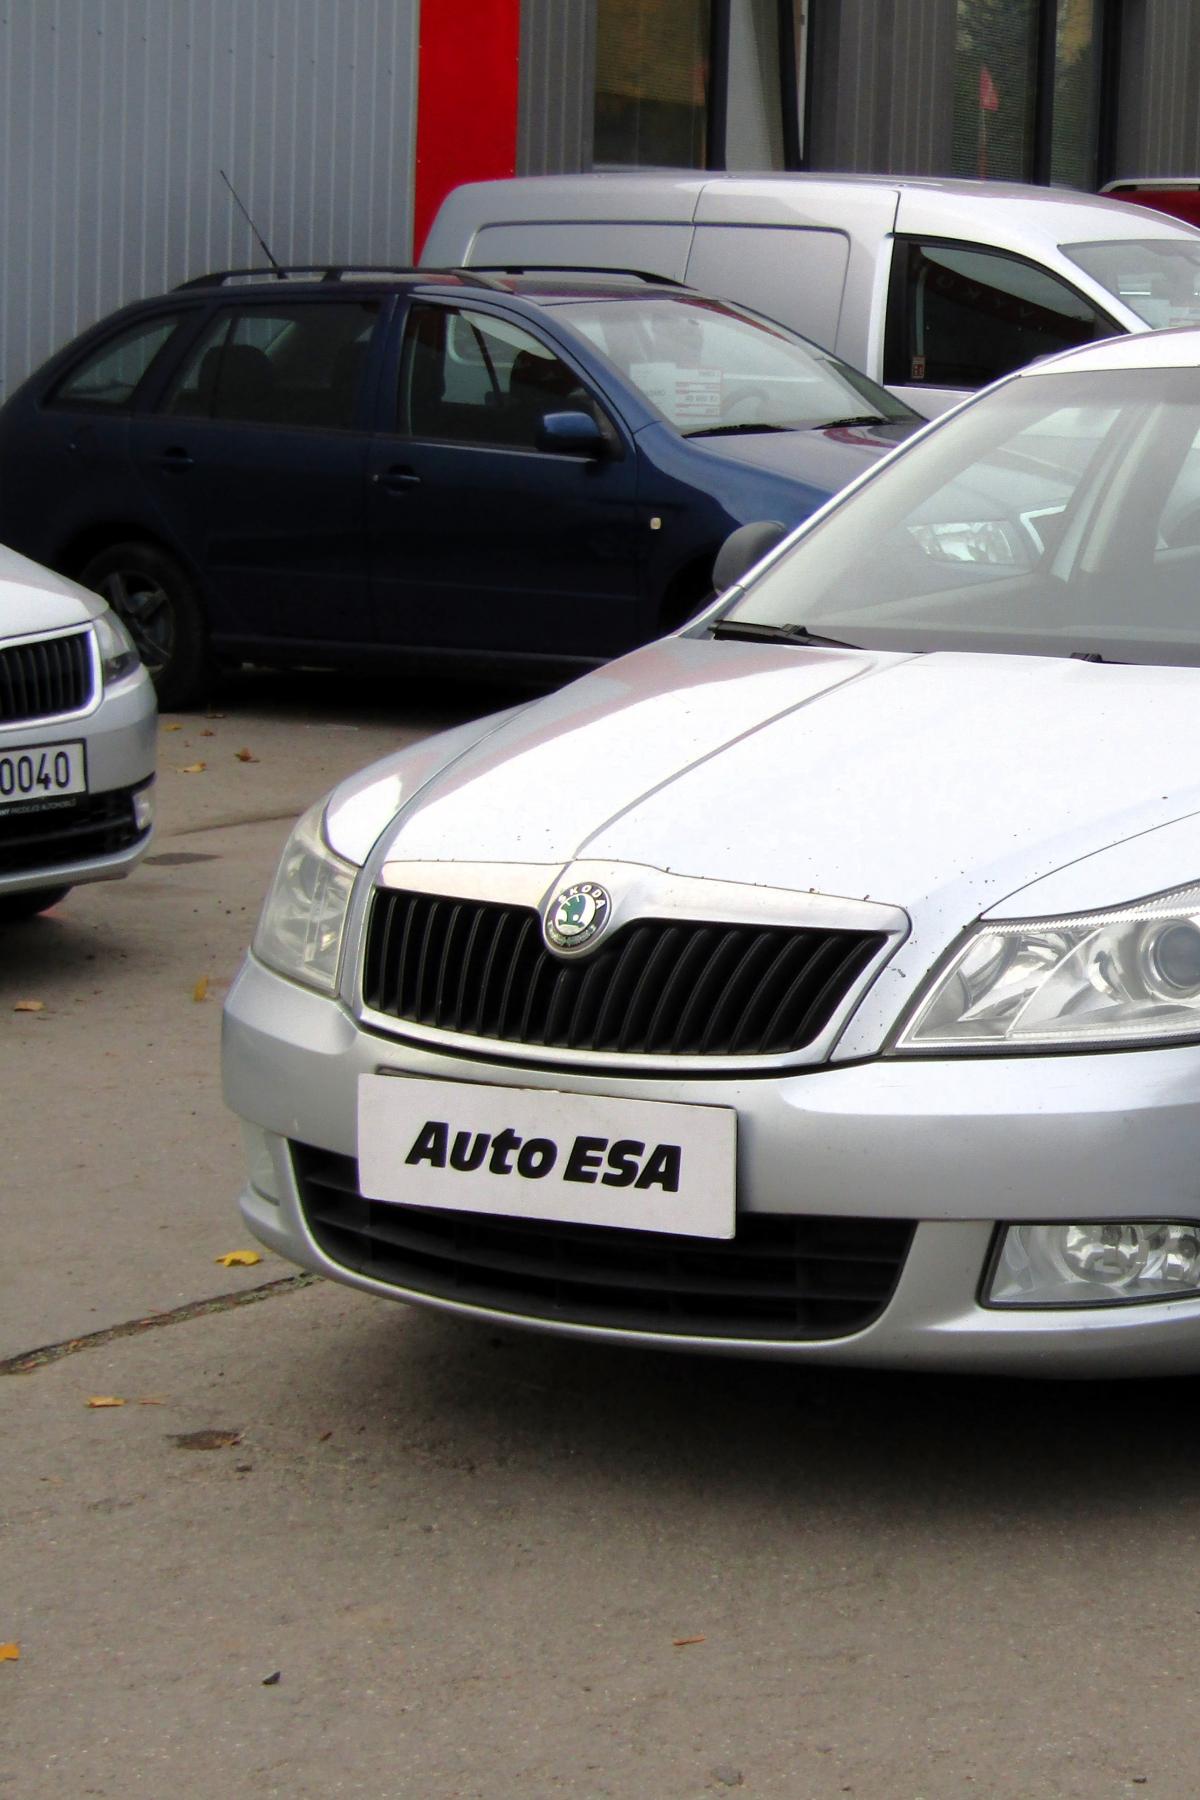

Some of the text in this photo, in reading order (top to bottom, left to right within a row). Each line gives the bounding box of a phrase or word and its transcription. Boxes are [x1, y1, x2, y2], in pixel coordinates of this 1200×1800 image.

[0, 751, 70, 795] 0040
[404, 1120, 682, 1193] Auto ESA
